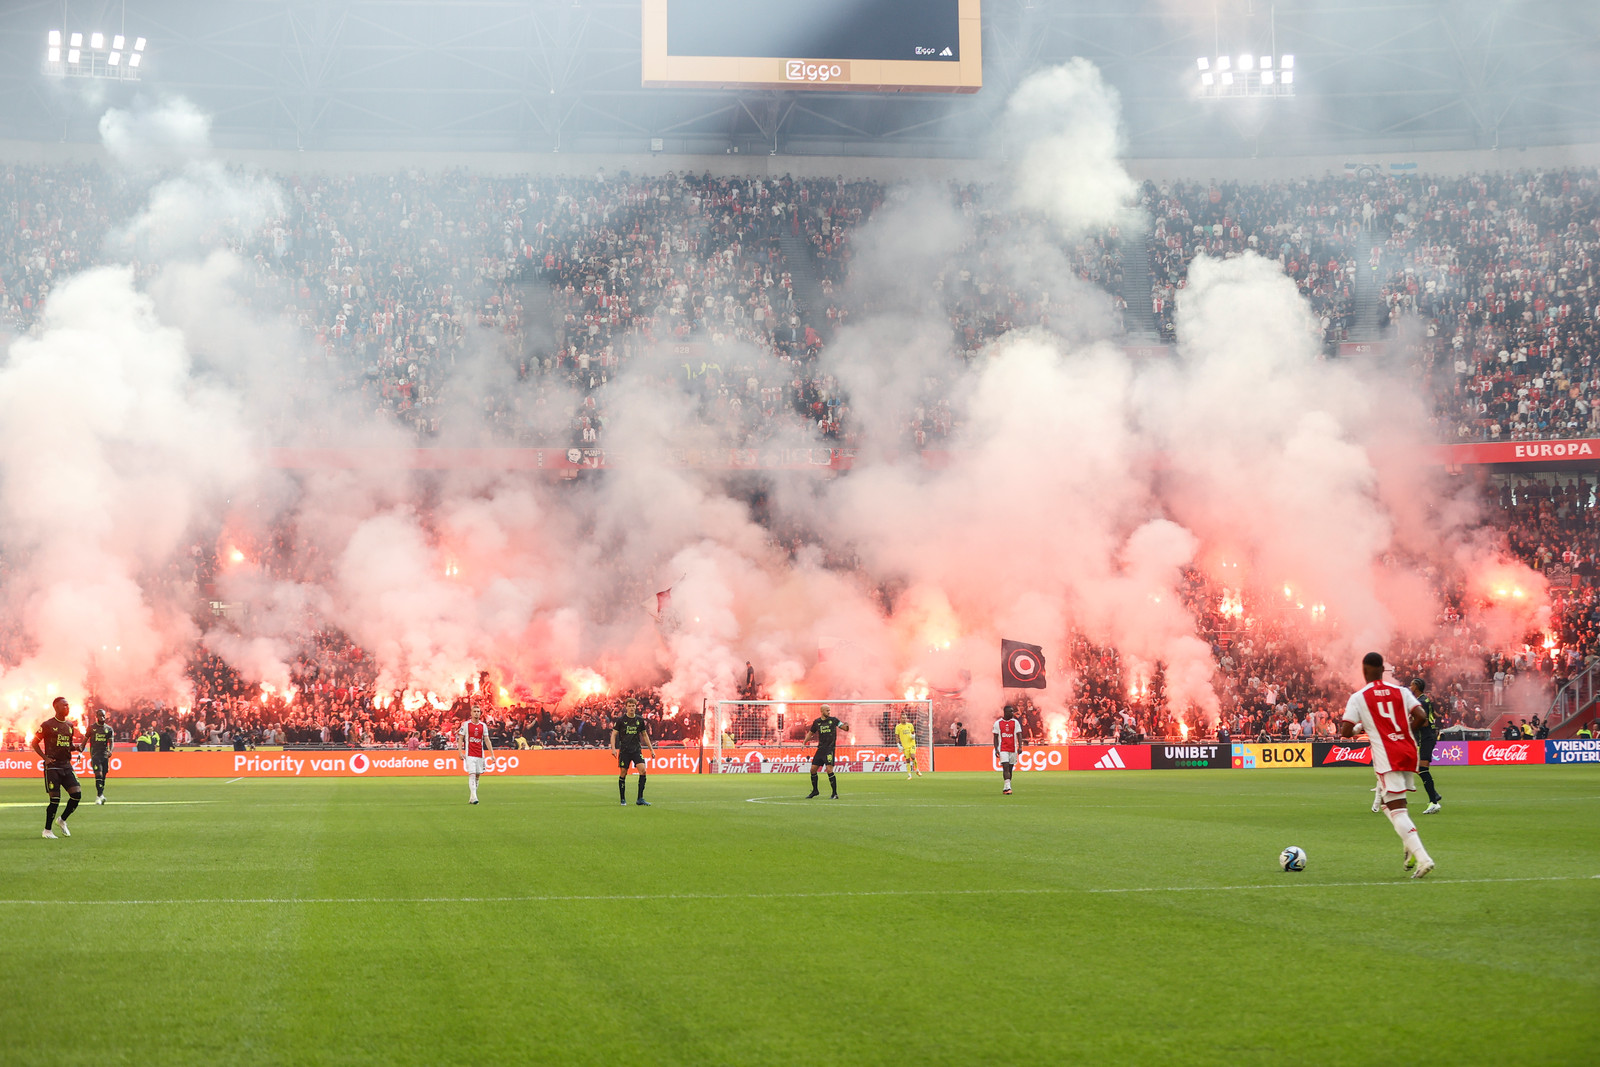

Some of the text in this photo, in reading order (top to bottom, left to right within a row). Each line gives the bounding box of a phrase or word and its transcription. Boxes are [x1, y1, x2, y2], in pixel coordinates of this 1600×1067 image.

[786, 60, 841, 81] Ziggo
[1515, 442, 1593, 458] EUROPA
[1377, 701, 1402, 732] 4
[1164, 746, 1218, 759] UNIBET
[1483, 744, 1530, 761] Coca-Cola
[1553, 741, 1600, 751] VRIENDE
[993, 748, 1062, 771] ggo
[1262, 748, 1306, 763] BLOX
[1332, 747, 1367, 761] Bud
[1561, 751, 1600, 763] LOTERI
[234, 755, 304, 775] Priority
[311, 758, 345, 771] van
[372, 757, 429, 768] vodafone
[433, 758, 457, 770] en
[631, 753, 700, 773] riority
[770, 763, 800, 773] Flink
[872, 762, 902, 772] Flink
